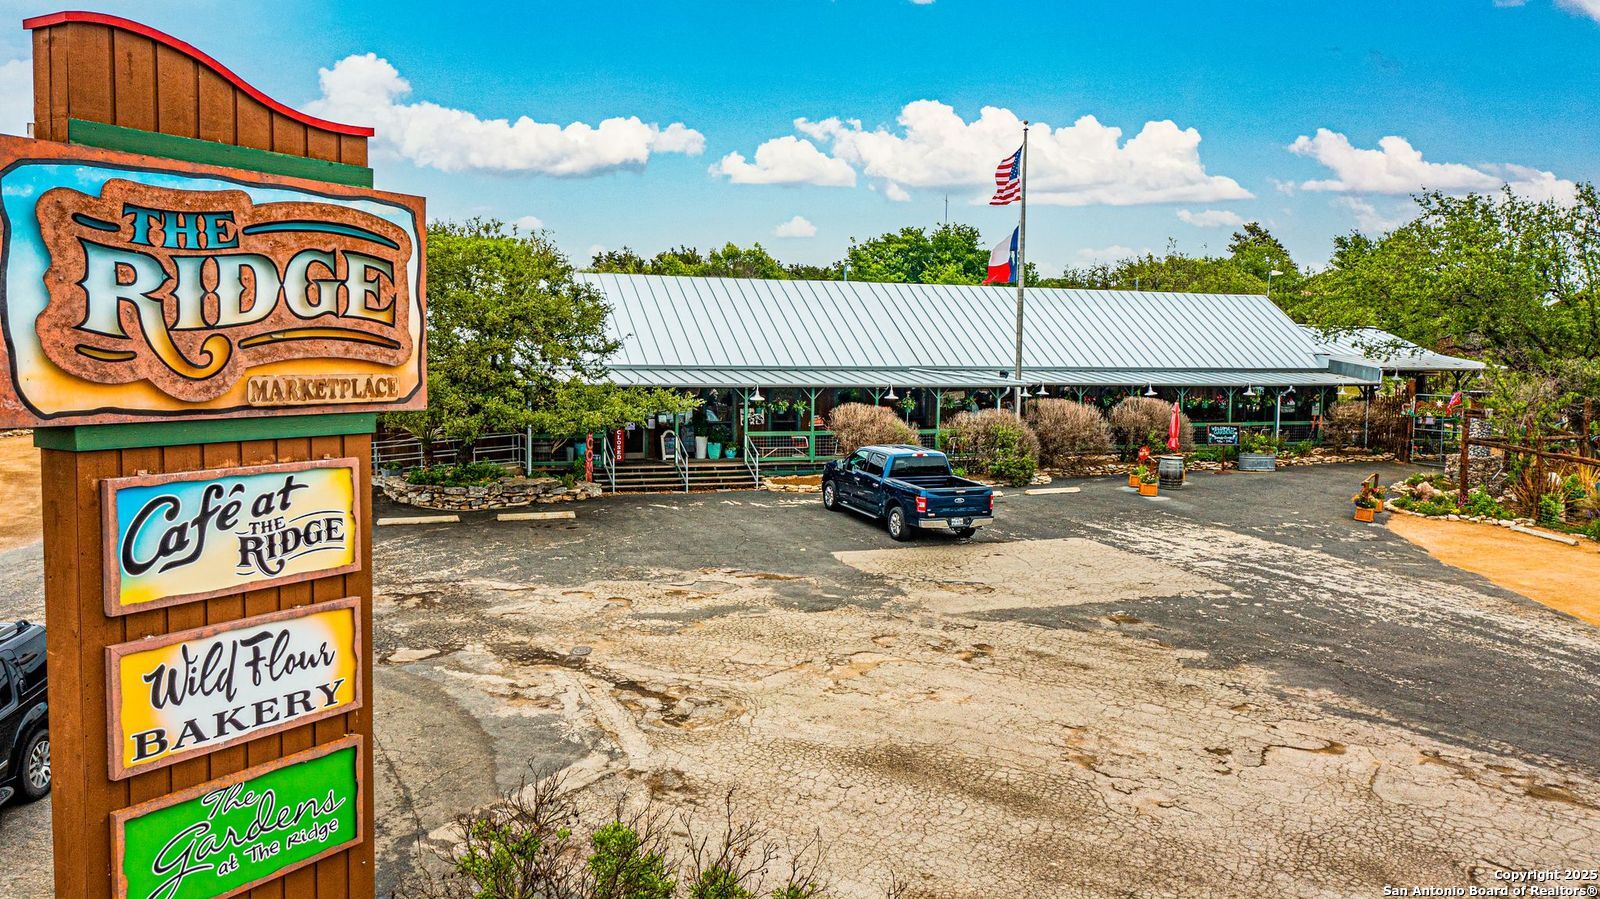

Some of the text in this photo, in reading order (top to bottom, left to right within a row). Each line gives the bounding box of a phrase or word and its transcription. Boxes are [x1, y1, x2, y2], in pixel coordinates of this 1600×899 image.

[122, 203, 239, 249] THE
[74, 237, 397, 380] RIDGE
[250, 378, 399, 403] MARKETPLACE
[251, 475, 309, 518] at
[238, 517, 345, 577] RIDGE
[249, 517, 286, 535] THE
[143, 629, 336, 709] Wild Flour
[132, 679, 345, 762] BAKERY
[202, 782, 259, 820] The
[146, 788, 346, 899] Gardens
[217, 818, 339, 876] at The Ridge
